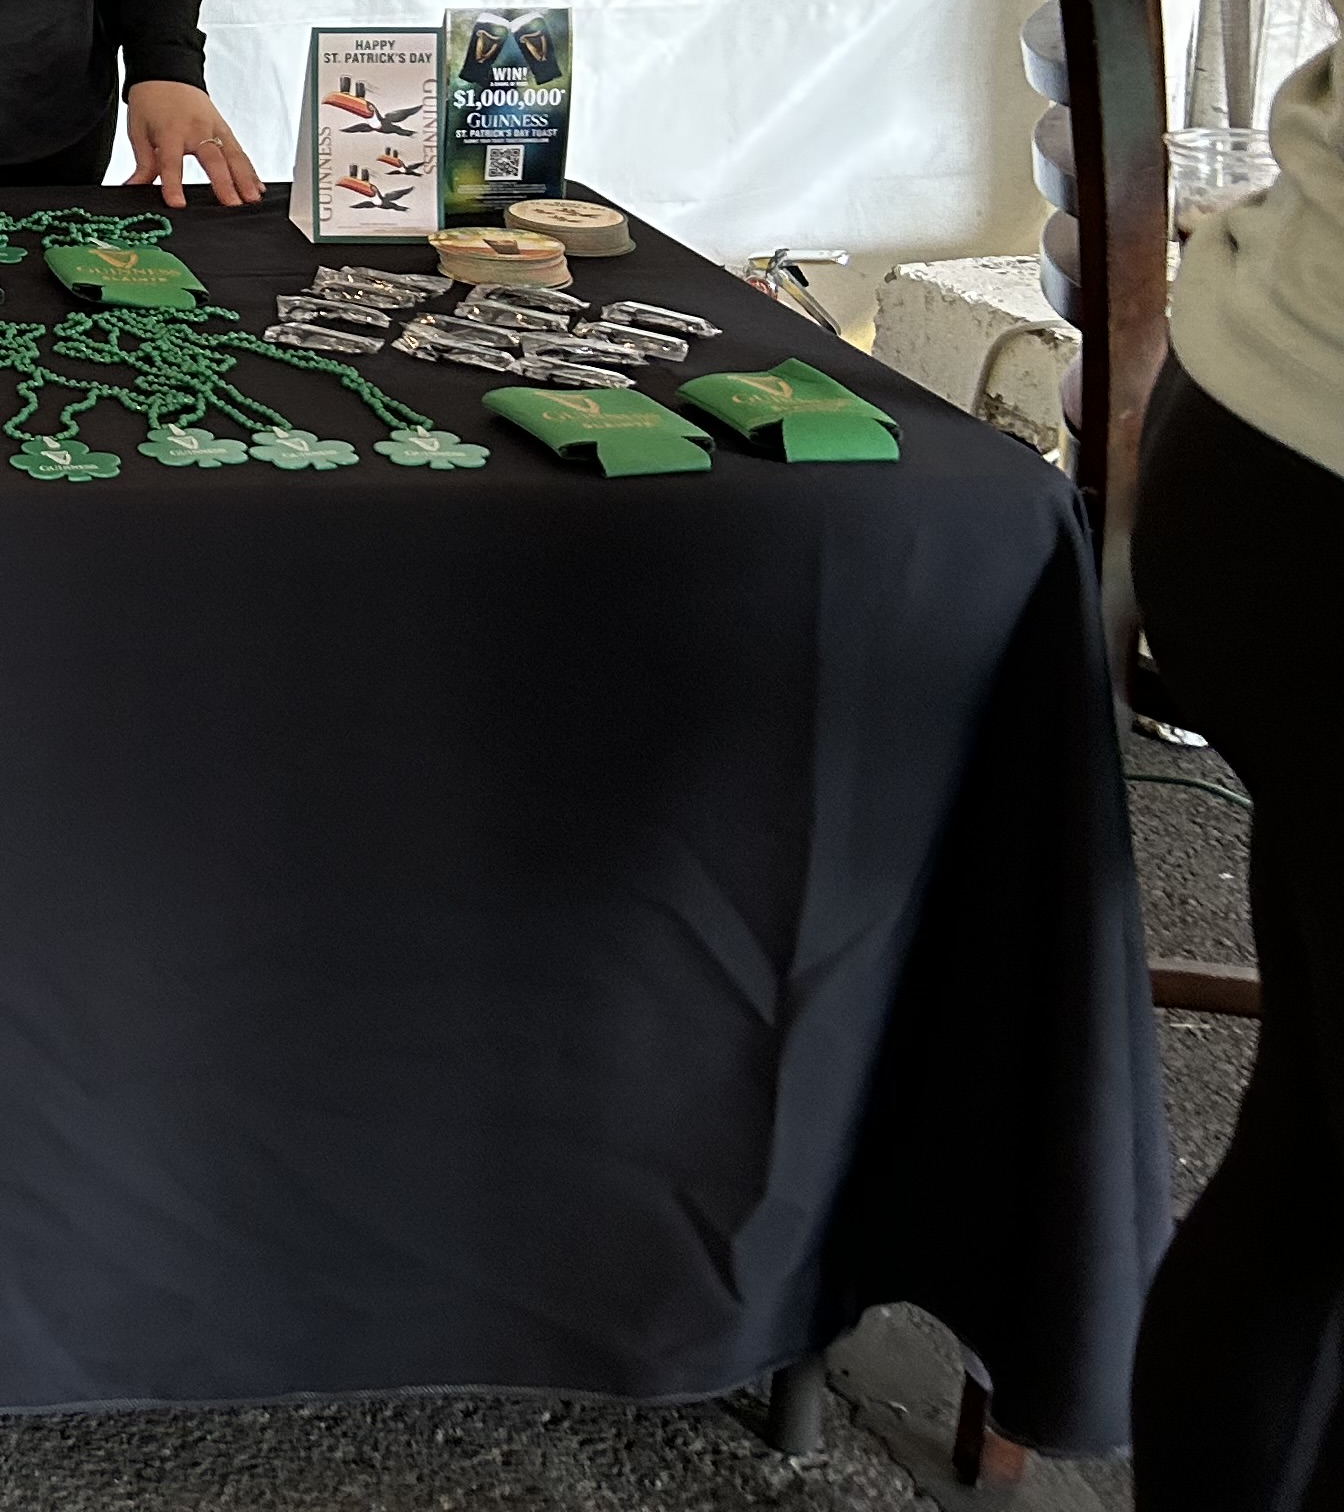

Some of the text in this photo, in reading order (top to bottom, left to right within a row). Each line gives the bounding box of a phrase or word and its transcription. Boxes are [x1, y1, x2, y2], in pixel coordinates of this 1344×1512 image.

[355, 39, 396, 51] HAPPY
[323, 53, 433, 64] ST. PATRICK'S DAY
[492, 66, 528, 81] WIN!
[422, 78, 438, 175] GUINNESS
[466, 112, 549, 129] GUINNESS
[318, 126, 333, 223] GUINNESS
